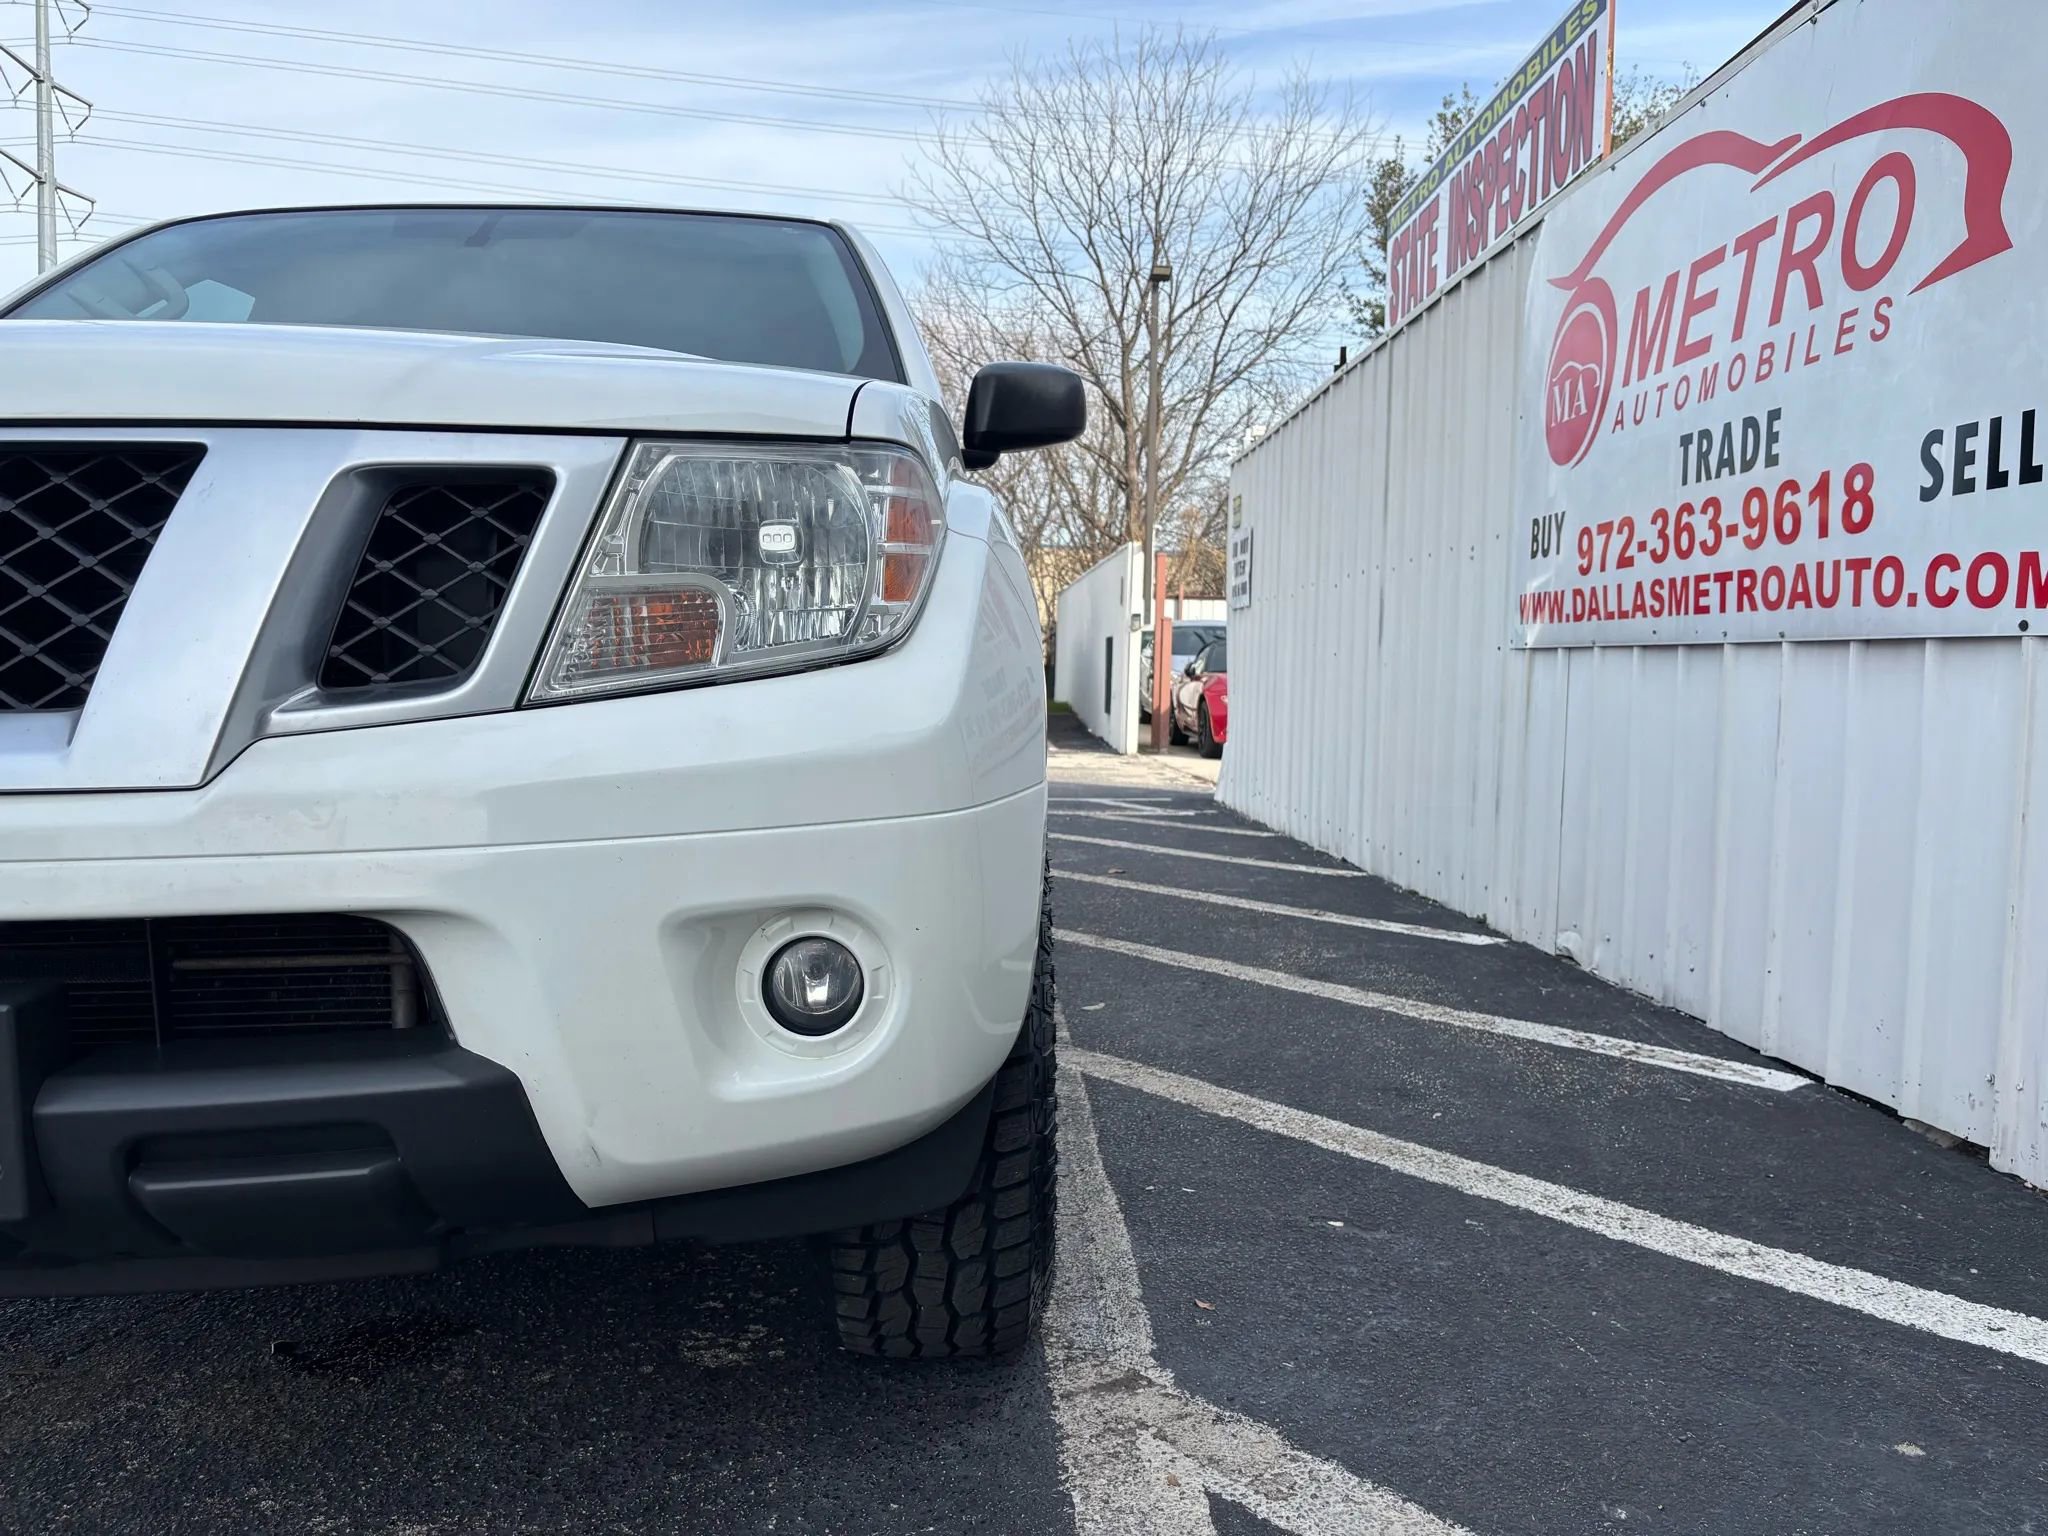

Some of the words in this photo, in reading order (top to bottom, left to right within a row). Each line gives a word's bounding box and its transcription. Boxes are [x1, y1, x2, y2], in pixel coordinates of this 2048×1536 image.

[1390, 168, 1440, 233] METRO
[1443, 0, 1599, 177] AUTOMOBILES
[1389, 192, 1439, 328] STATE
[1446, 29, 1597, 279] INSPECTION
[1621, 151, 1916, 388] METRO
[1551, 372, 1588, 428] MA
[1611, 296, 1893, 434] AUTOMOBILES
[1679, 407, 1783, 486] TRADE
[1919, 408, 2044, 503] SELL
[1530, 511, 1566, 560] BUY
[1577, 462, 1875, 576] 972-363-9618
[1519, 551, 2048, 625] WWW.DALLASMETROAUTO.COM
